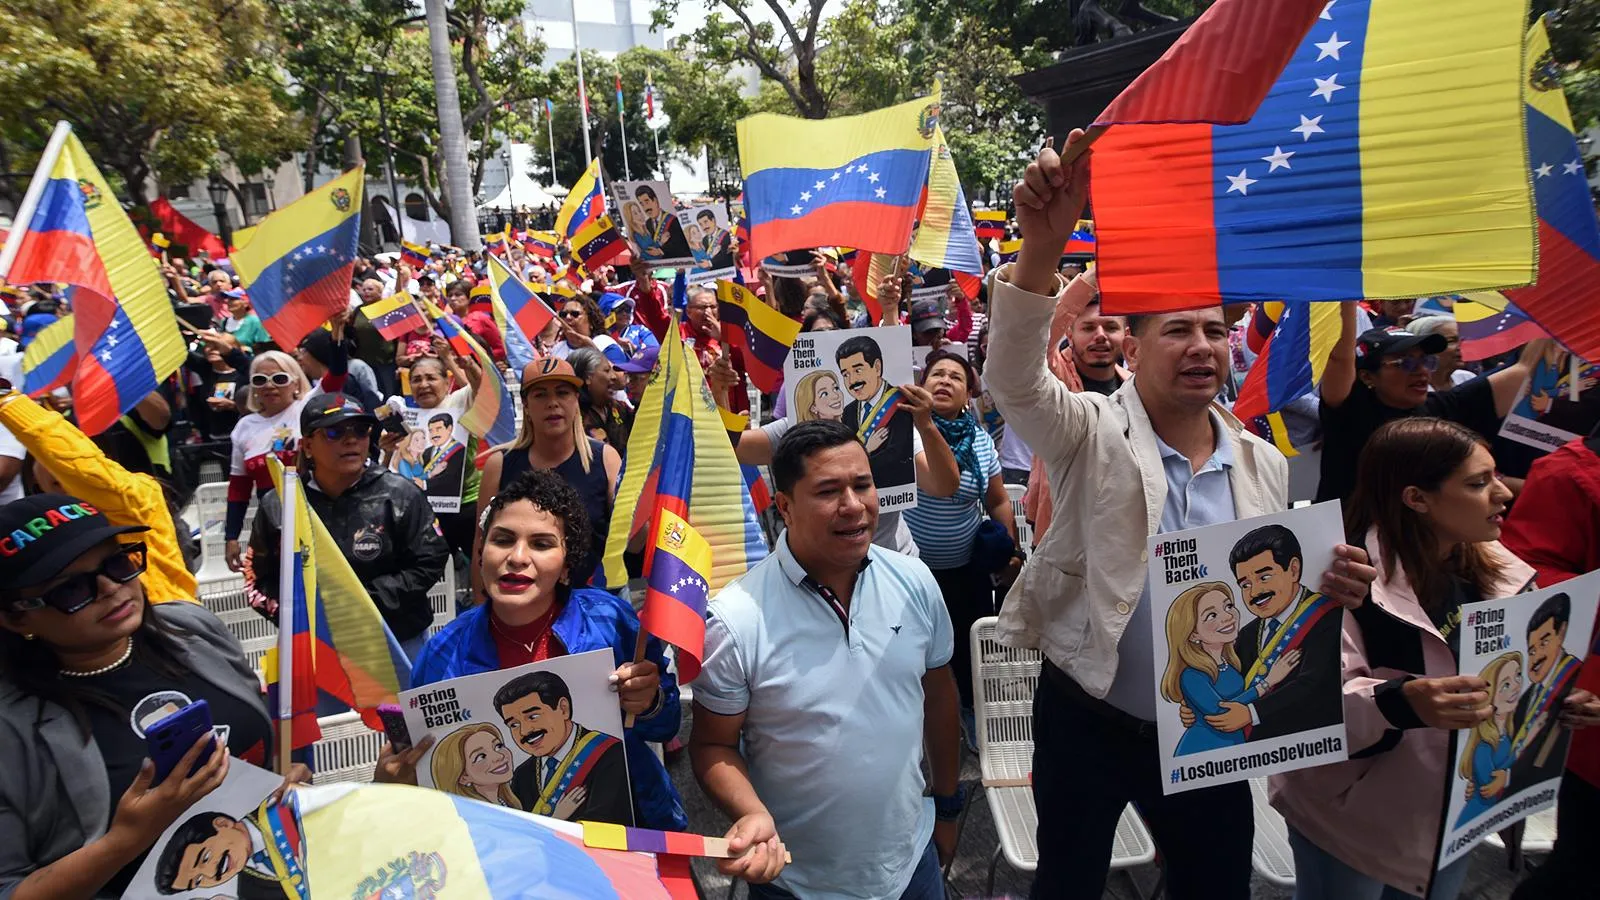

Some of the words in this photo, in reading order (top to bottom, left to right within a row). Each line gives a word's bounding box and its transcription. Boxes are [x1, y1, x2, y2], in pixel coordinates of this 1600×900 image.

[792, 338, 815, 349] Bring
[792, 349, 815, 359] Them
[0, 502, 98, 557] CARACAS
[1155, 538, 1197, 557] #Bring
[1163, 553, 1198, 570] Them
[1467, 608, 1505, 627] #Bring
[1474, 623, 1504, 640] Them
[409, 687, 457, 709] #Bring
[420, 699, 460, 717] Them
[1170, 736, 1342, 784] #LosQueremosDeVuelta
